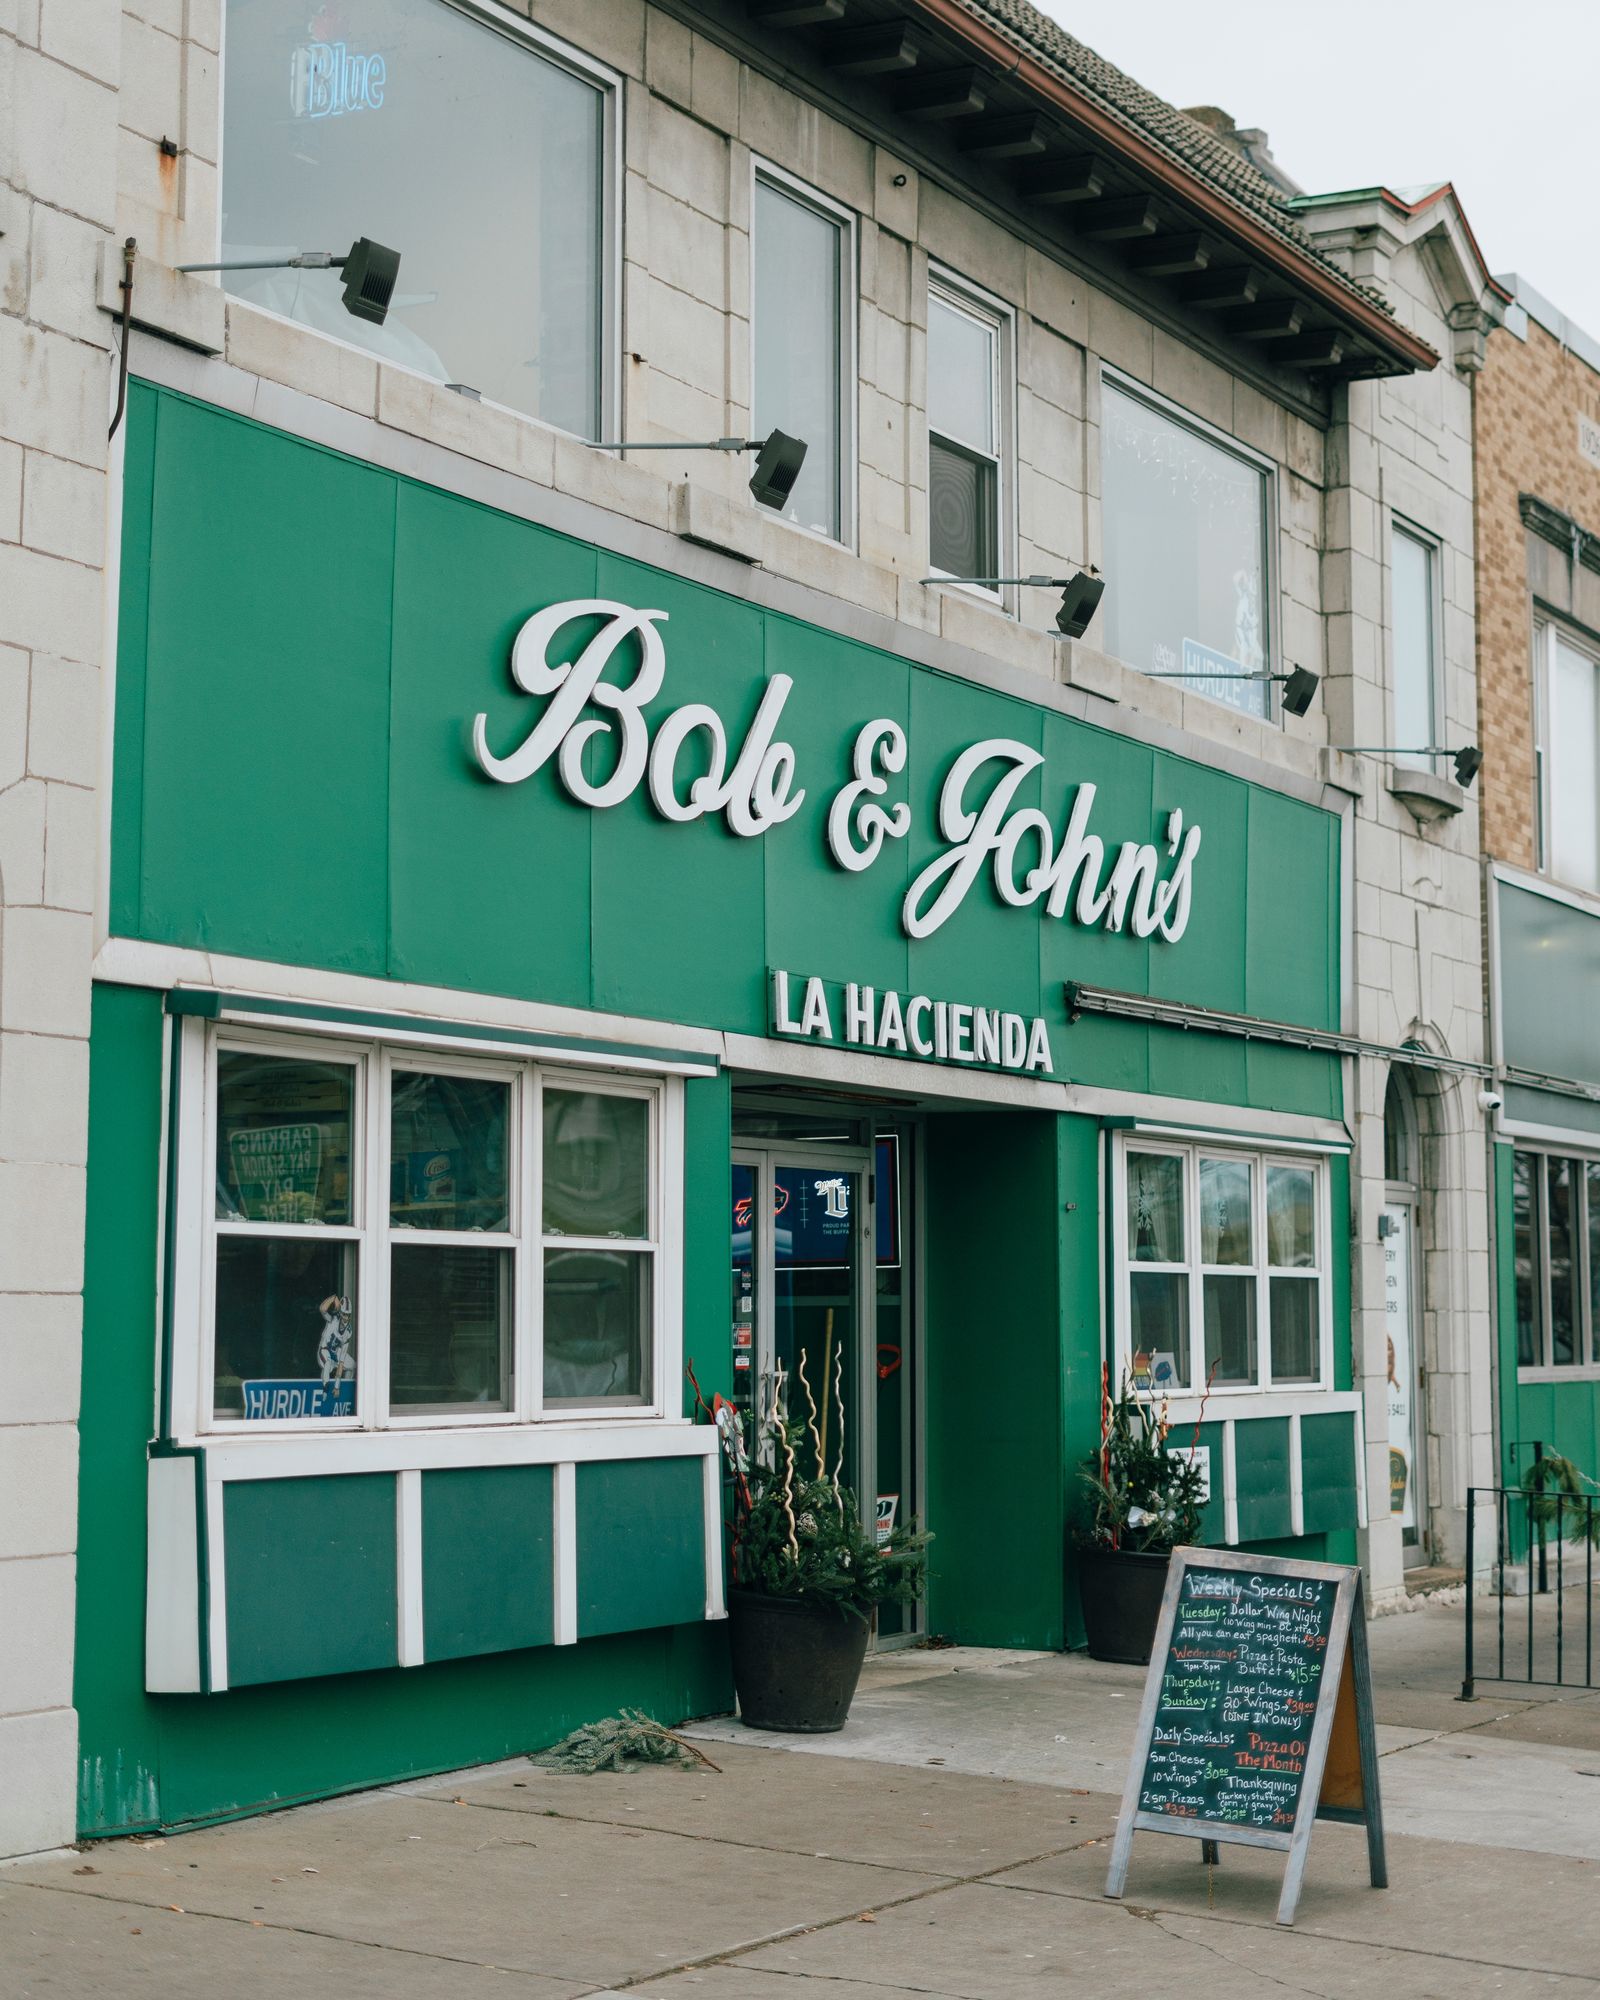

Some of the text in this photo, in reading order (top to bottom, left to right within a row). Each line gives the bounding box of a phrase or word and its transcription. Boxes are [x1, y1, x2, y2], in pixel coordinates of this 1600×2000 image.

[307, 42, 386, 118] Blue
[1186, 650, 1241, 707] HURDLE
[473, 599, 1201, 943] Bob & John's
[775, 970, 1053, 1073] LA HACIENDA
[824, 1186, 850, 1219] Li
[249, 1389, 352, 1419] HURDLE AVE
[1185, 1573, 1323, 1604] Weekly Specials:
[1179, 1603, 1321, 1626] Tuesday: Dollar Wing Night
[1223, 1618, 1235, 1627] (10
[1235, 1617, 1255, 1633] Wing
[1180, 1626, 1194, 1639] All
[1195, 1630, 1213, 1641] you
[1216, 1629, 1231, 1638] can
[1233, 1630, 1251, 1640] eat
[1171, 1645, 1238, 1662] Wednesday:
[1238, 1644, 1267, 1660] Pizza
[1276, 1648, 1306, 1666] Pasta
[1236, 1661, 1282, 1676] Buffet
[1164, 1675, 1220, 1691] Thursday:
[1227, 1680, 1256, 1698] Large
[1258, 1681, 1295, 1697] Cheese
[1162, 1694, 1217, 1710] Sunday:
[1224, 1696, 1241, 1709] 20
[1243, 1696, 1281, 1716] Wings
[1223, 1709, 1302, 1731] (DINE IN ONLY)
[1154, 1726, 1235, 1746] Daily Specials:
[1248, 1732, 1288, 1754] Pizza
[1168, 1751, 1206, 1765] Cheese
[1234, 1751, 1303, 1773] The Month
[1152, 1772, 1163, 1782] 10
[1163, 1771, 1198, 1788] Wings
[1225, 1774, 1298, 1797] Thanksgiving
[1143, 1791, 1150, 1803] 2
[1169, 1788, 1205, 1805] Pizzas
